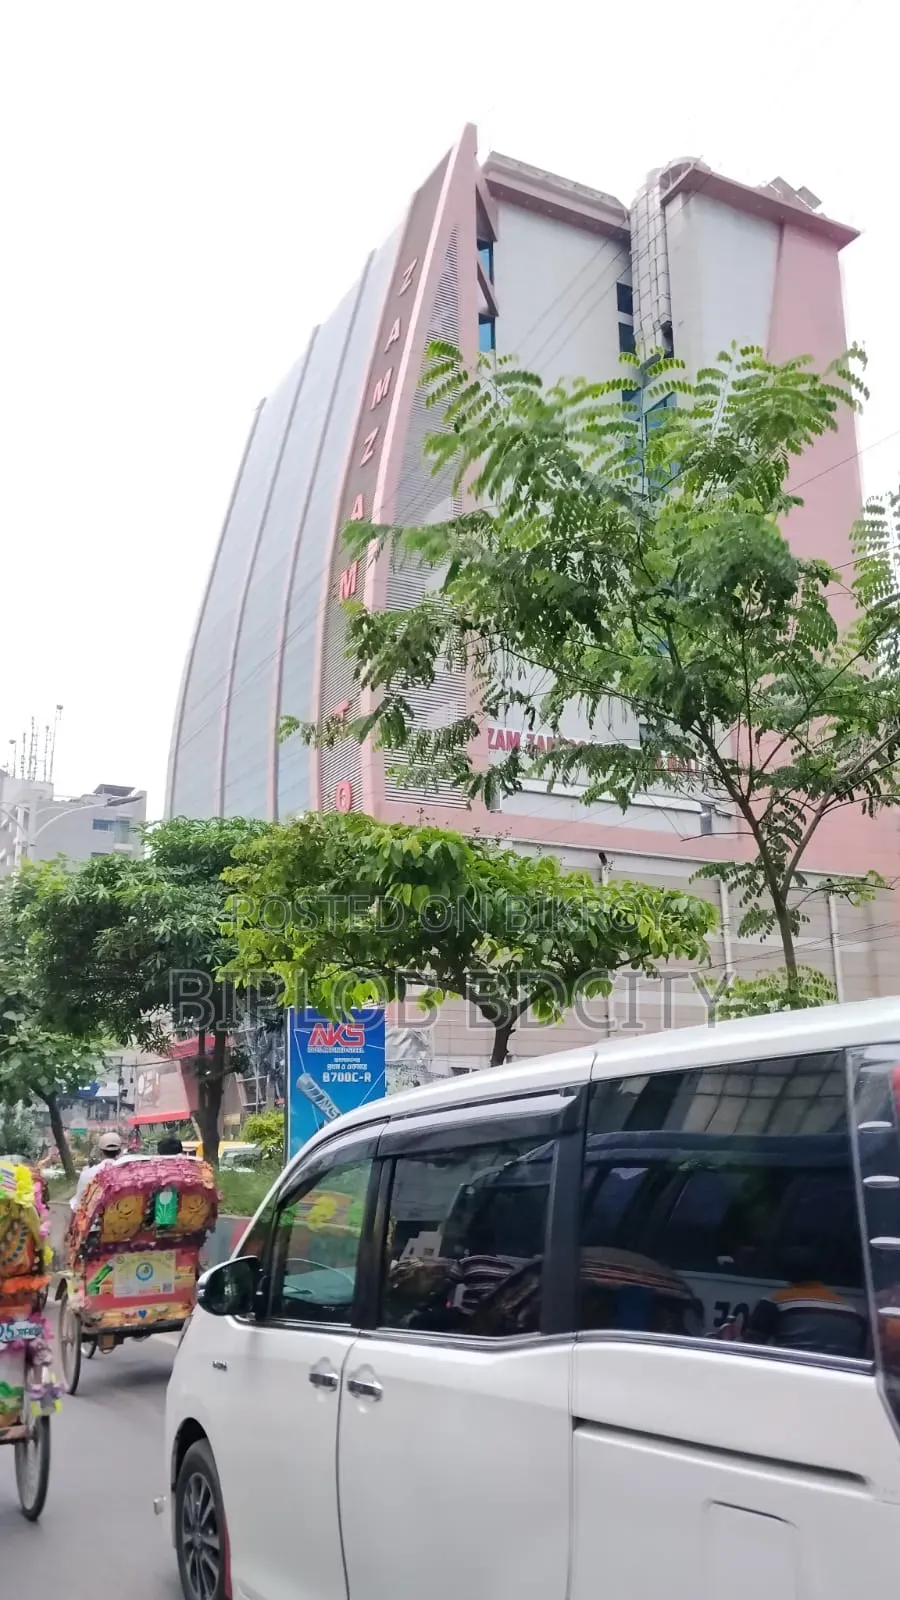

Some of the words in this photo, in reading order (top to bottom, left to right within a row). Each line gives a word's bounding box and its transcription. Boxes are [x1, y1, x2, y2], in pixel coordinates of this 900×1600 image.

[488, 727, 521, 752] ZAM
[308, 1023, 365, 1047] AKS
[322, 1071, 372, 1083] B700C-R
